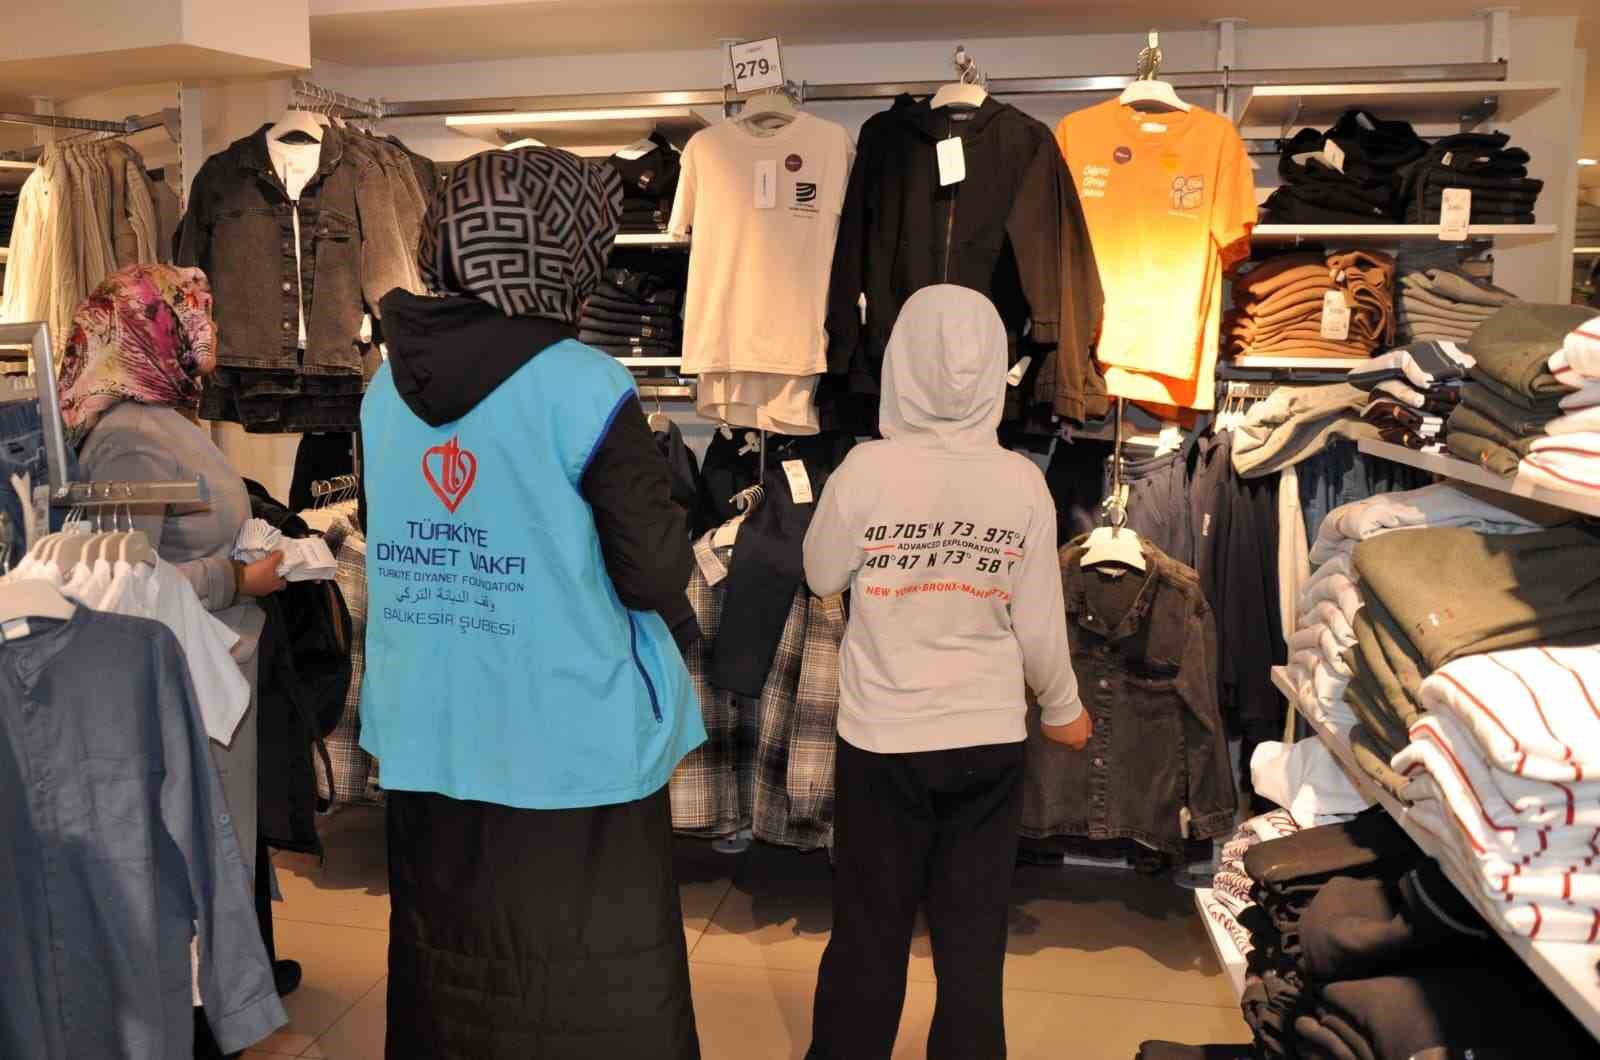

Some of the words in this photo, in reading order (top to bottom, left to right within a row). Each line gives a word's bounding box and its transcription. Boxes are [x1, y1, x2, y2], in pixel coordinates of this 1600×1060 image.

[735, 58, 769, 79] 279
[407, 518, 489, 548] TÜRKİYE
[897, 540, 941, 550] ADVANCED
[942, 539, 1000, 555] EXPLORATION
[376, 540, 461, 567] DİYANET
[470, 551, 526, 575] VAKFI
[975, 557, 1002, 573] 58
[462, 575, 525, 593] FOUNDATION
[865, 585, 891, 597] NEW
